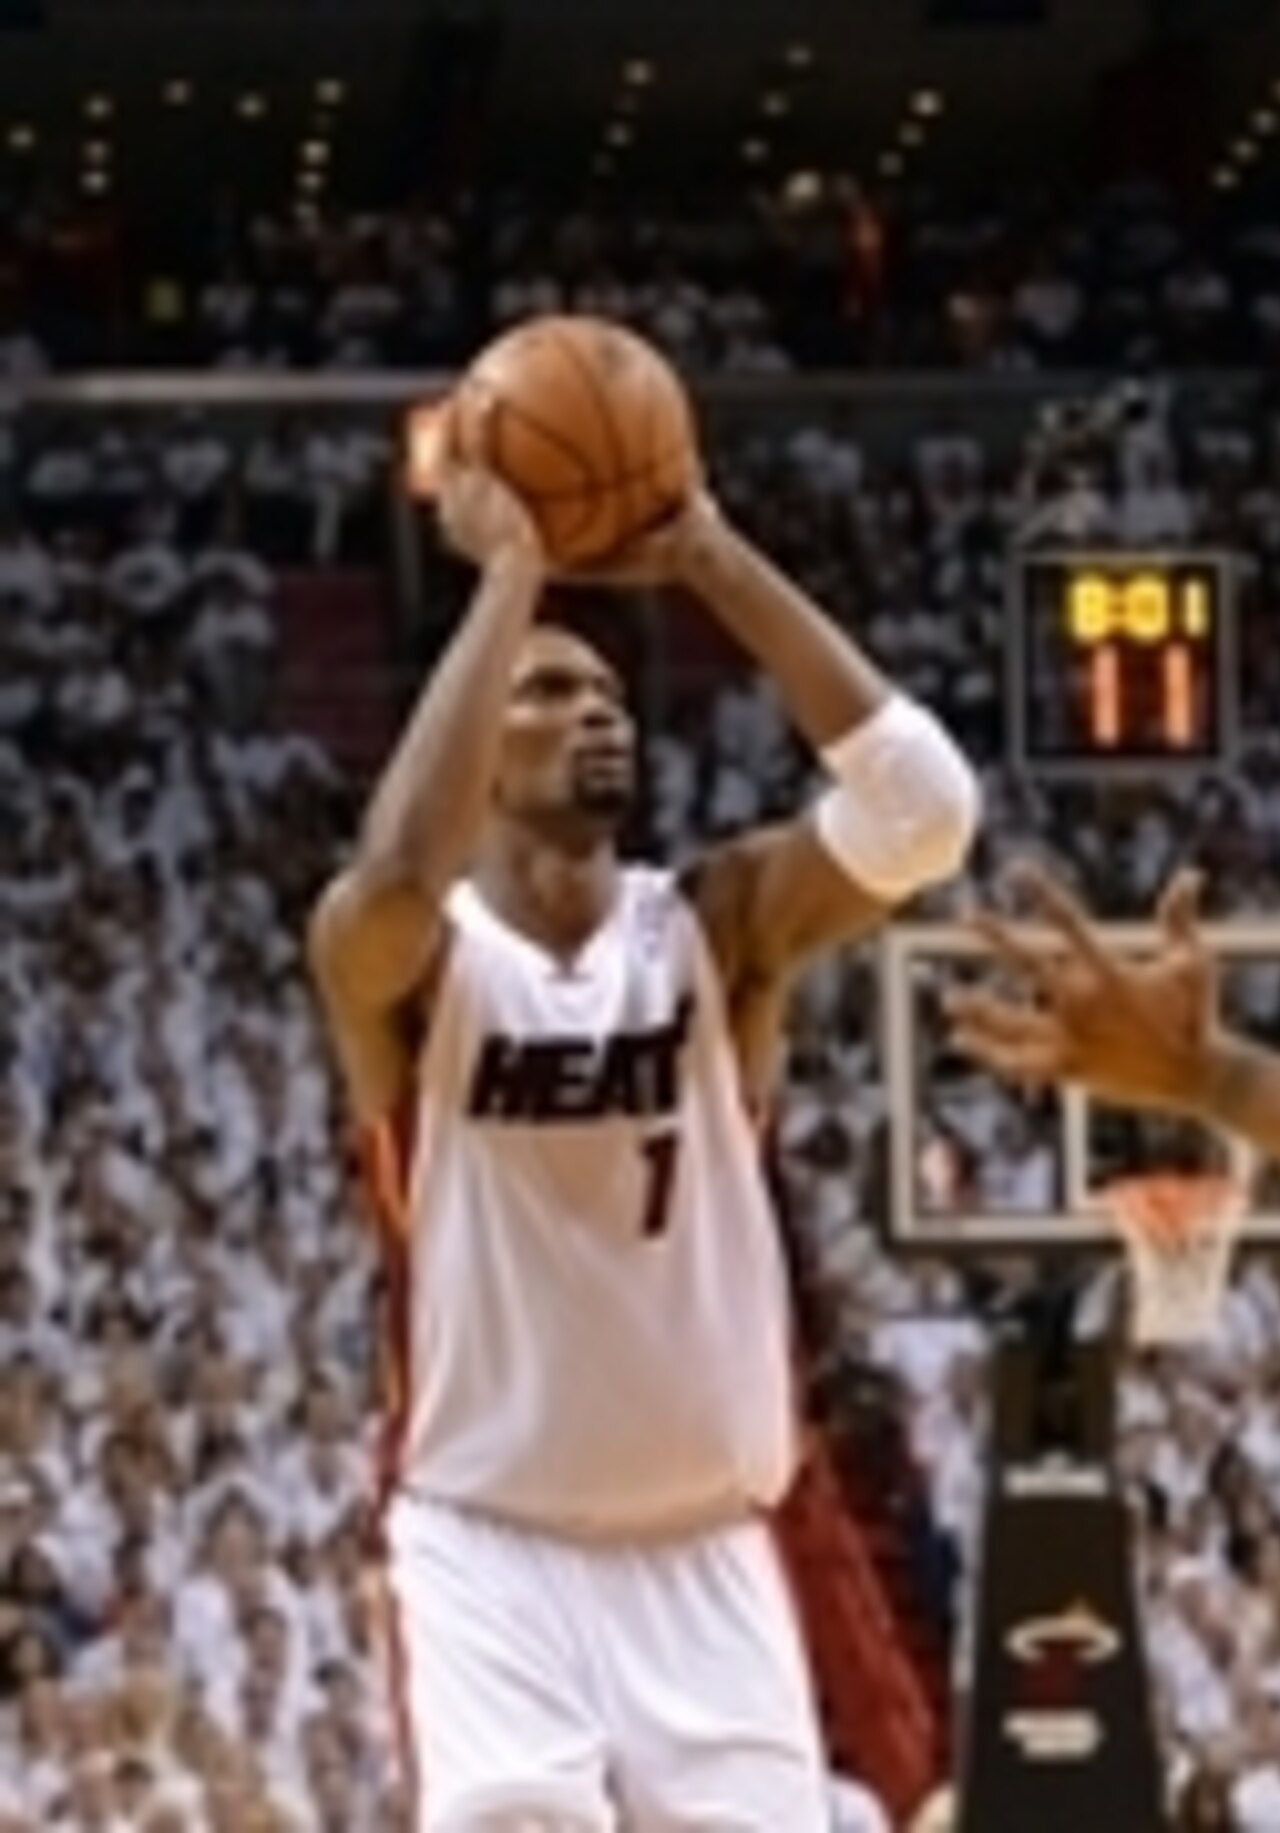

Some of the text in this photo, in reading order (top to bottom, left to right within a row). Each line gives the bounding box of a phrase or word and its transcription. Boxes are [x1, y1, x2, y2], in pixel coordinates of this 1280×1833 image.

[1094, 647, 1191, 746] 11
[466, 994, 696, 1122] HEAT
[640, 1130, 679, 1240] 1
